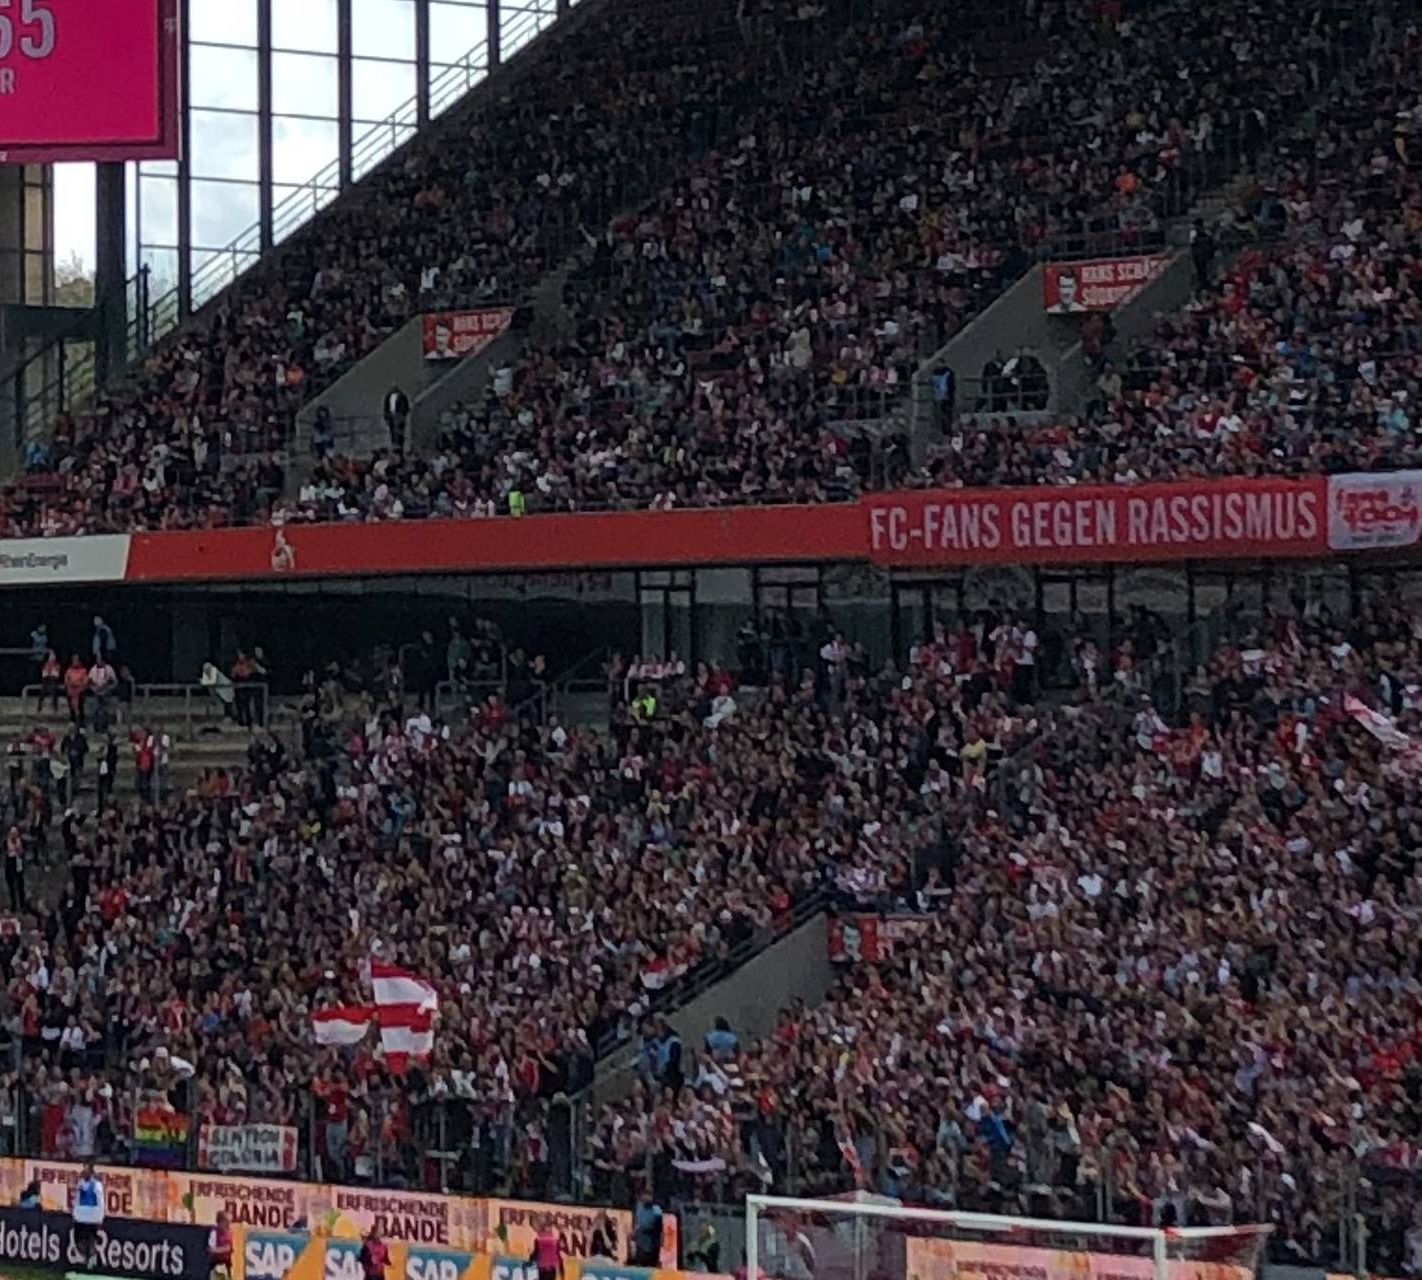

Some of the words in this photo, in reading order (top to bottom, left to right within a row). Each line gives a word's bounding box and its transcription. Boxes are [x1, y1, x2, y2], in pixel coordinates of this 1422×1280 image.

[870, 503, 1001, 551] FC-FANS
[1012, 499, 1116, 546] GEGEN
[1127, 491, 1318, 543] RASSISMUS
[67, 1184, 133, 1214] BDE
[226, 1198, 296, 1228] BANDE
[337, 1192, 449, 1218] ERFRISCHENDE
[375, 1214, 449, 1245] BANDE
[95, 1229, 184, 1275] Resorts
[246, 1241, 294, 1277] SAP
